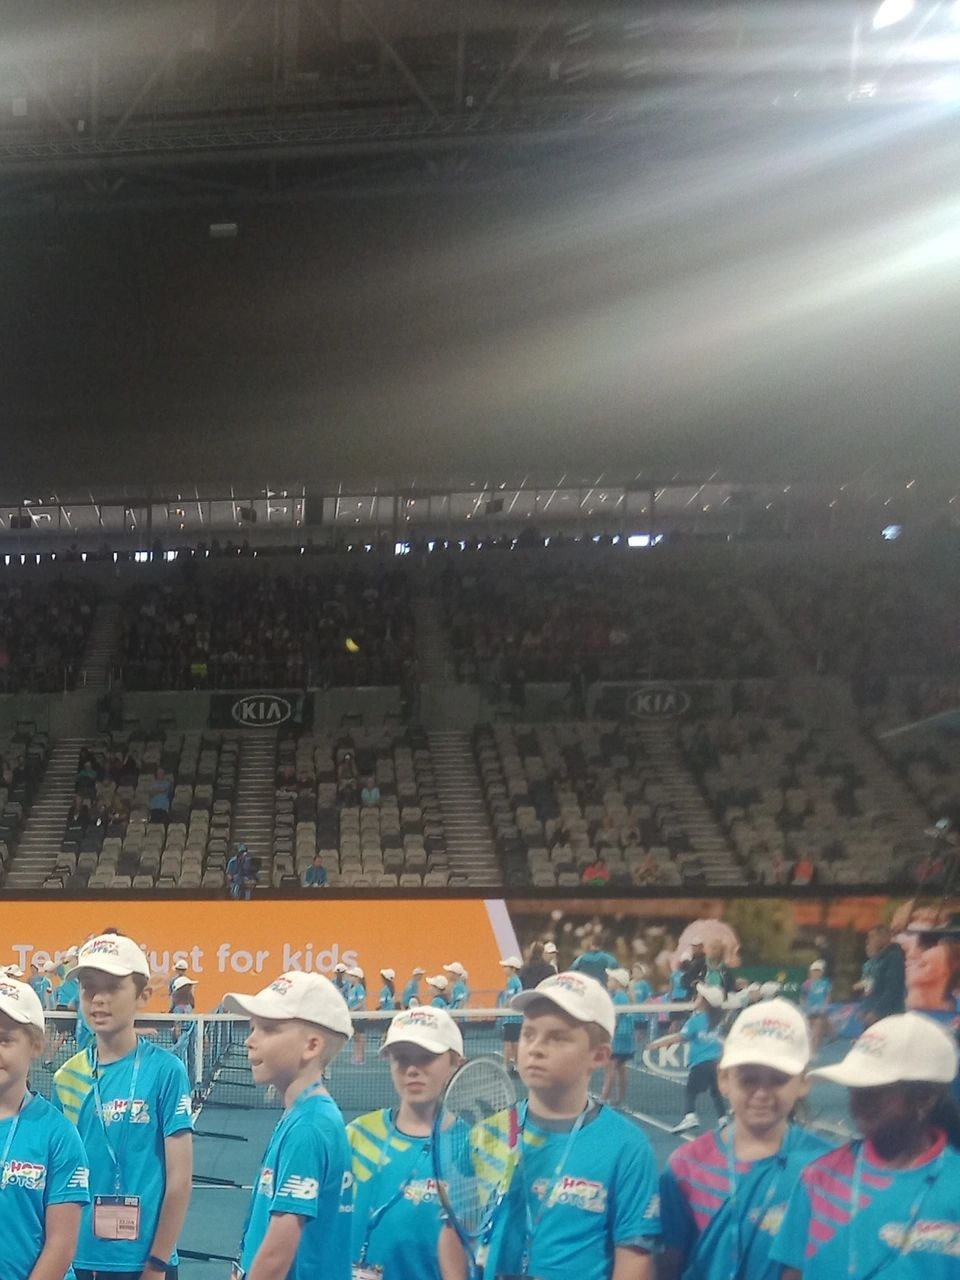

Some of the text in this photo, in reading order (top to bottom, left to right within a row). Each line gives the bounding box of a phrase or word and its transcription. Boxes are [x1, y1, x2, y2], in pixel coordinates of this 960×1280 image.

[243, 702, 281, 720] KIA
[638, 695, 675, 712] KIA
[217, 943, 270, 973] for
[281, 943, 360, 973] kids
